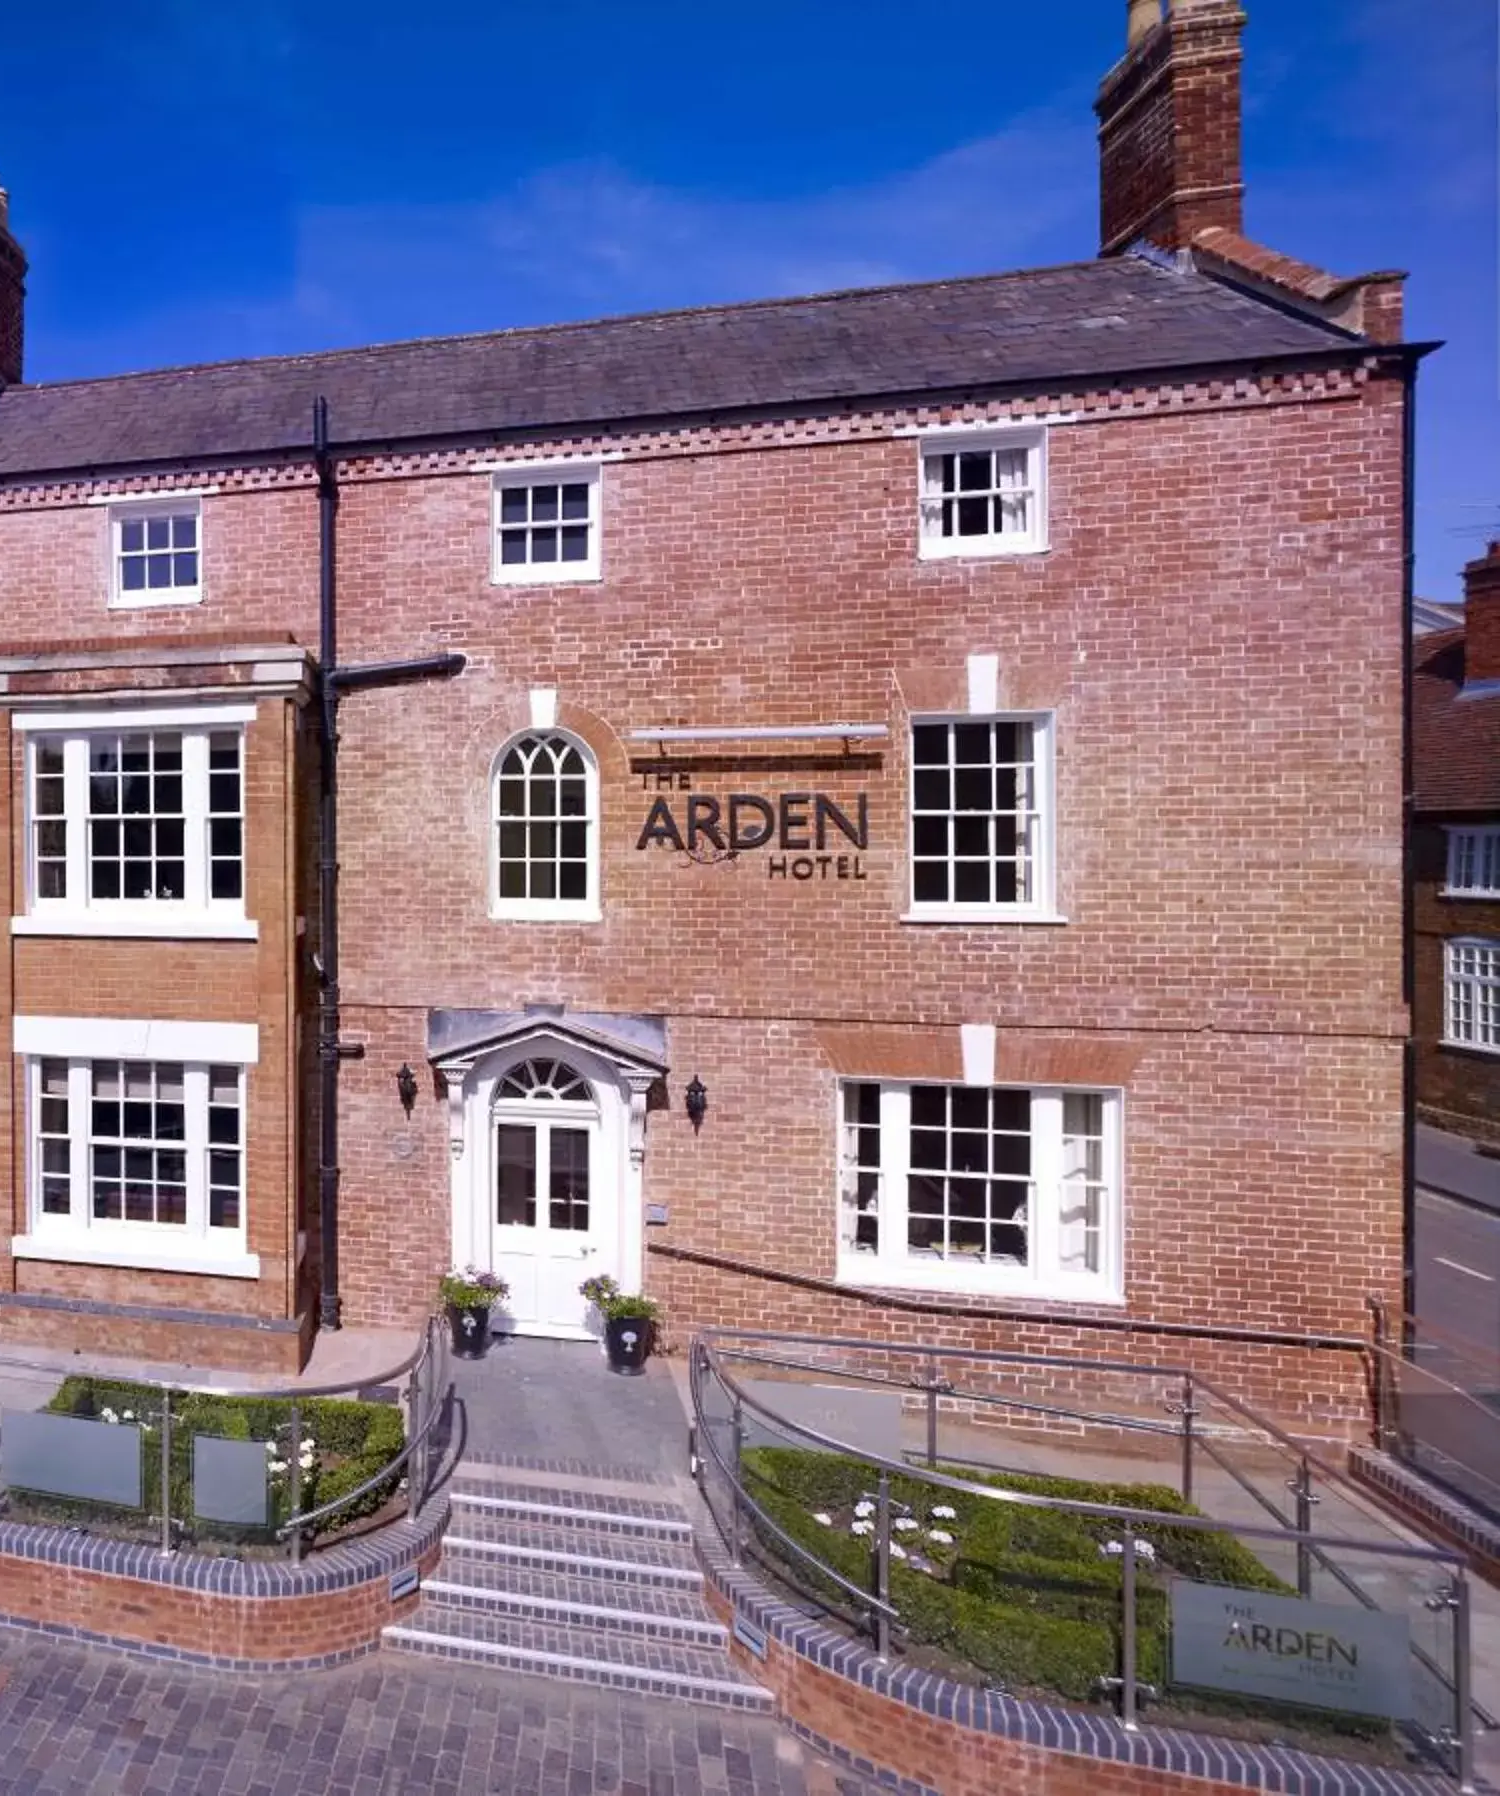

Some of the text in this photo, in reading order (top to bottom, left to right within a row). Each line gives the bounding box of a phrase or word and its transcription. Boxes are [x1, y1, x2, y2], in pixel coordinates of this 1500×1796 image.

[641, 772, 690, 789] THE
[636, 793, 868, 850] ARDEN
[769, 856, 866, 880] HOTEL
[1224, 1602, 1255, 1619] THE
[1223, 1622, 1358, 1668] ARDEN
